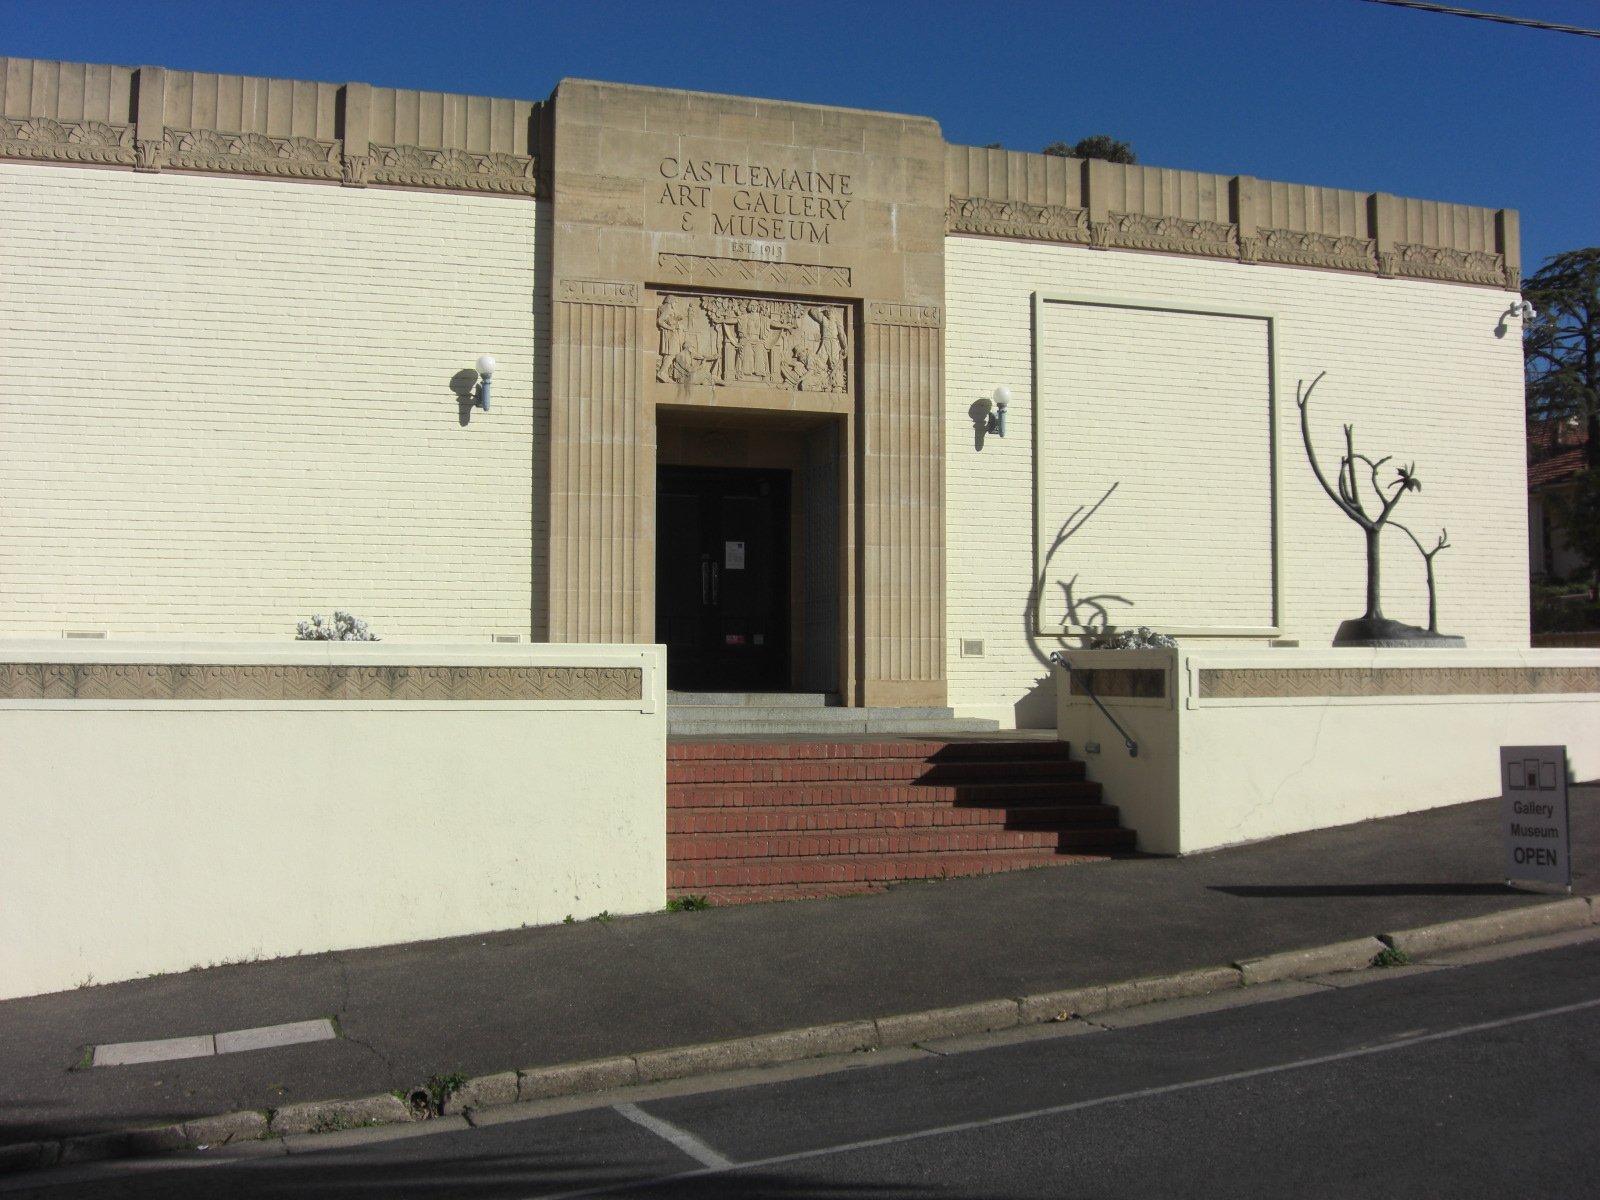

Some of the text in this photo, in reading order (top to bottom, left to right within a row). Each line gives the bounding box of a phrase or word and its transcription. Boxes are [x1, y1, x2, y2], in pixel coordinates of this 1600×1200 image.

[659, 157, 853, 195] CASTLEMAINE
[657, 182, 852, 221] ART GALLERY
[712, 213, 830, 244] MUSEUM
[1513, 801, 1554, 818] Gallery
[1510, 823, 1559, 838] Museum
[1514, 847, 1557, 866] OPEN
